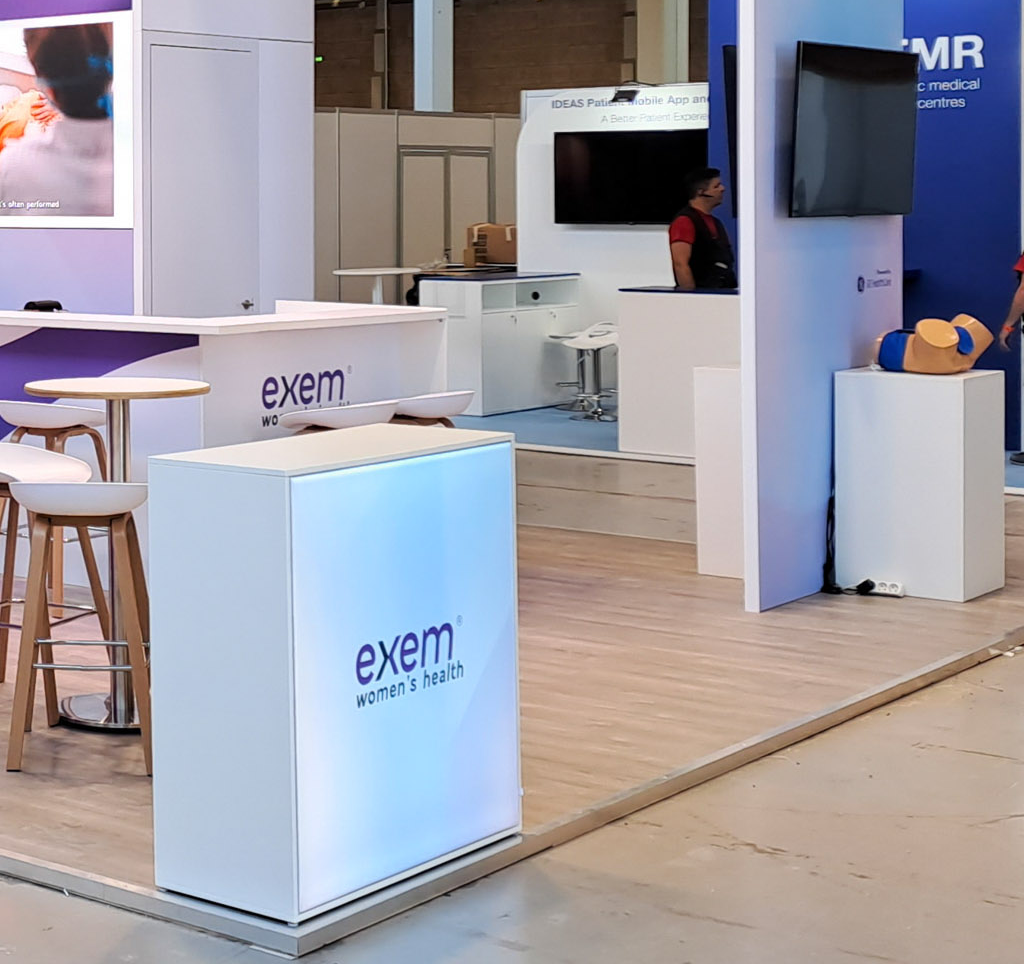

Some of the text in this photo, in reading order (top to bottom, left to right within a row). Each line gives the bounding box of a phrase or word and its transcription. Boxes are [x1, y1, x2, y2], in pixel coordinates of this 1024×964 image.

[902, 34, 984, 71] MR
[928, 78, 981, 92] medical
[551, 99, 585, 110] IDEAS
[667, 94, 690, 106] App
[917, 97, 966, 110] centres
[26, 200, 61, 211] performed
[356, 660, 464, 709] women's health
